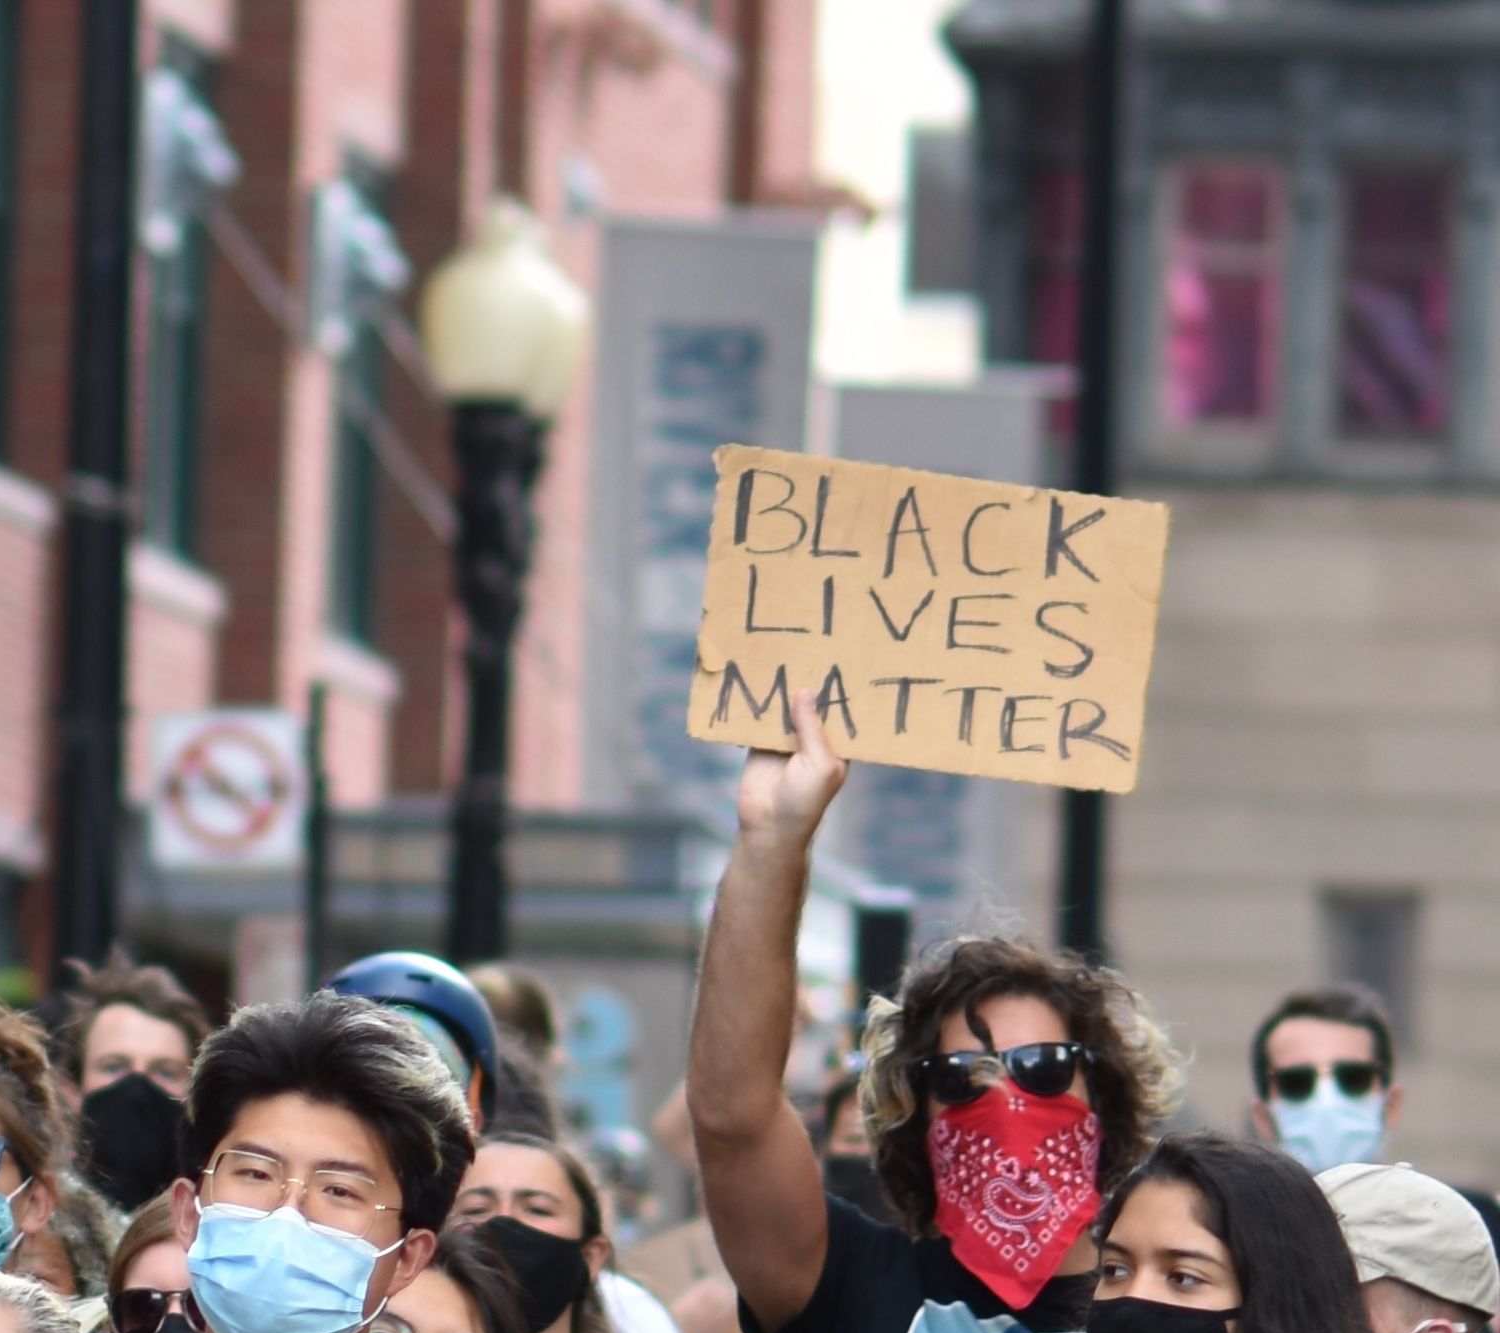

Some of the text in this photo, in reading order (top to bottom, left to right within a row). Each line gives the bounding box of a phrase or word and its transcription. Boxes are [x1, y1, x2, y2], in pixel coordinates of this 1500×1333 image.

[734, 468, 1106, 582] BLACK
[745, 563, 1095, 679] LIVES
[708, 660, 1132, 762] MATTER
